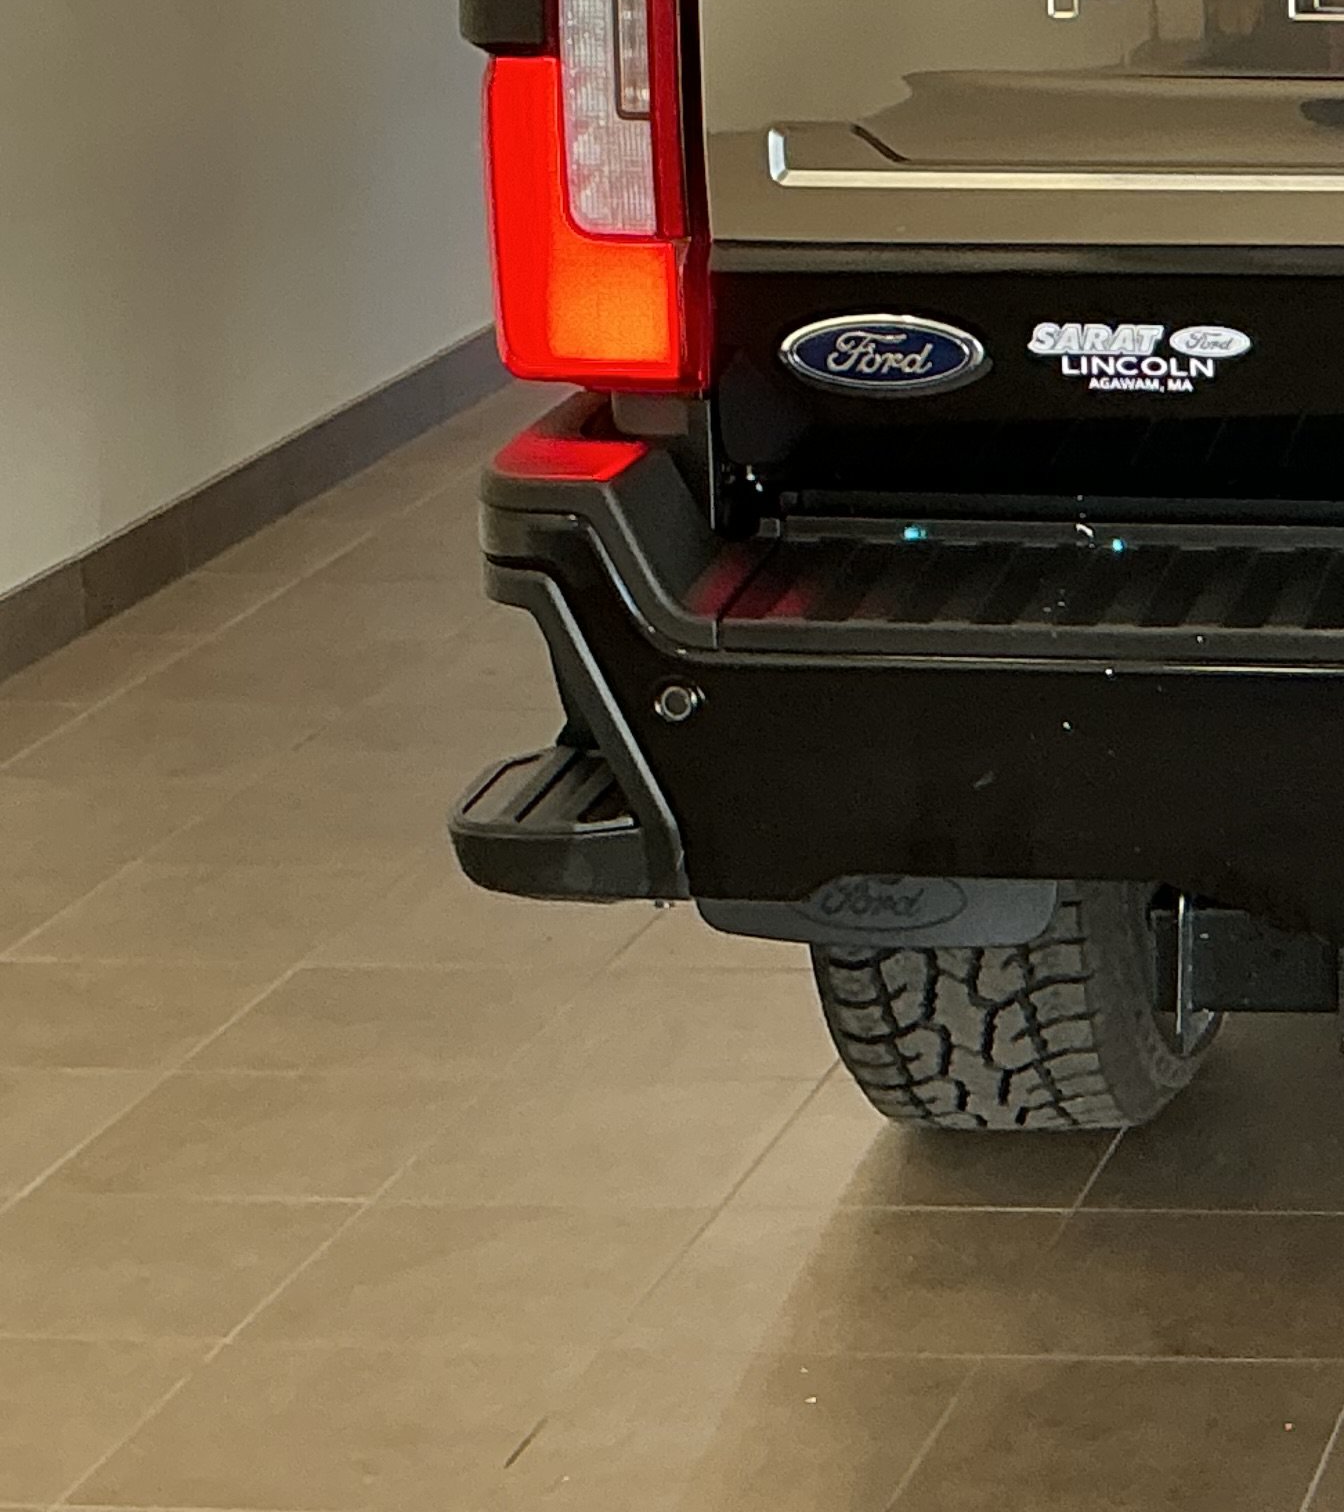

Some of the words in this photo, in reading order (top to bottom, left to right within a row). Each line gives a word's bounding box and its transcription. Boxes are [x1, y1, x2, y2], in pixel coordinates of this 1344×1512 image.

[826, 330, 932, 376] Ford
[1028, 322, 1164, 355] SARAT
[1061, 355, 1214, 378] LINCOLN
[1088, 376, 1165, 393] AGAWAM,
[1167, 379, 1194, 392] MA
[820, 875, 925, 917] Ford
